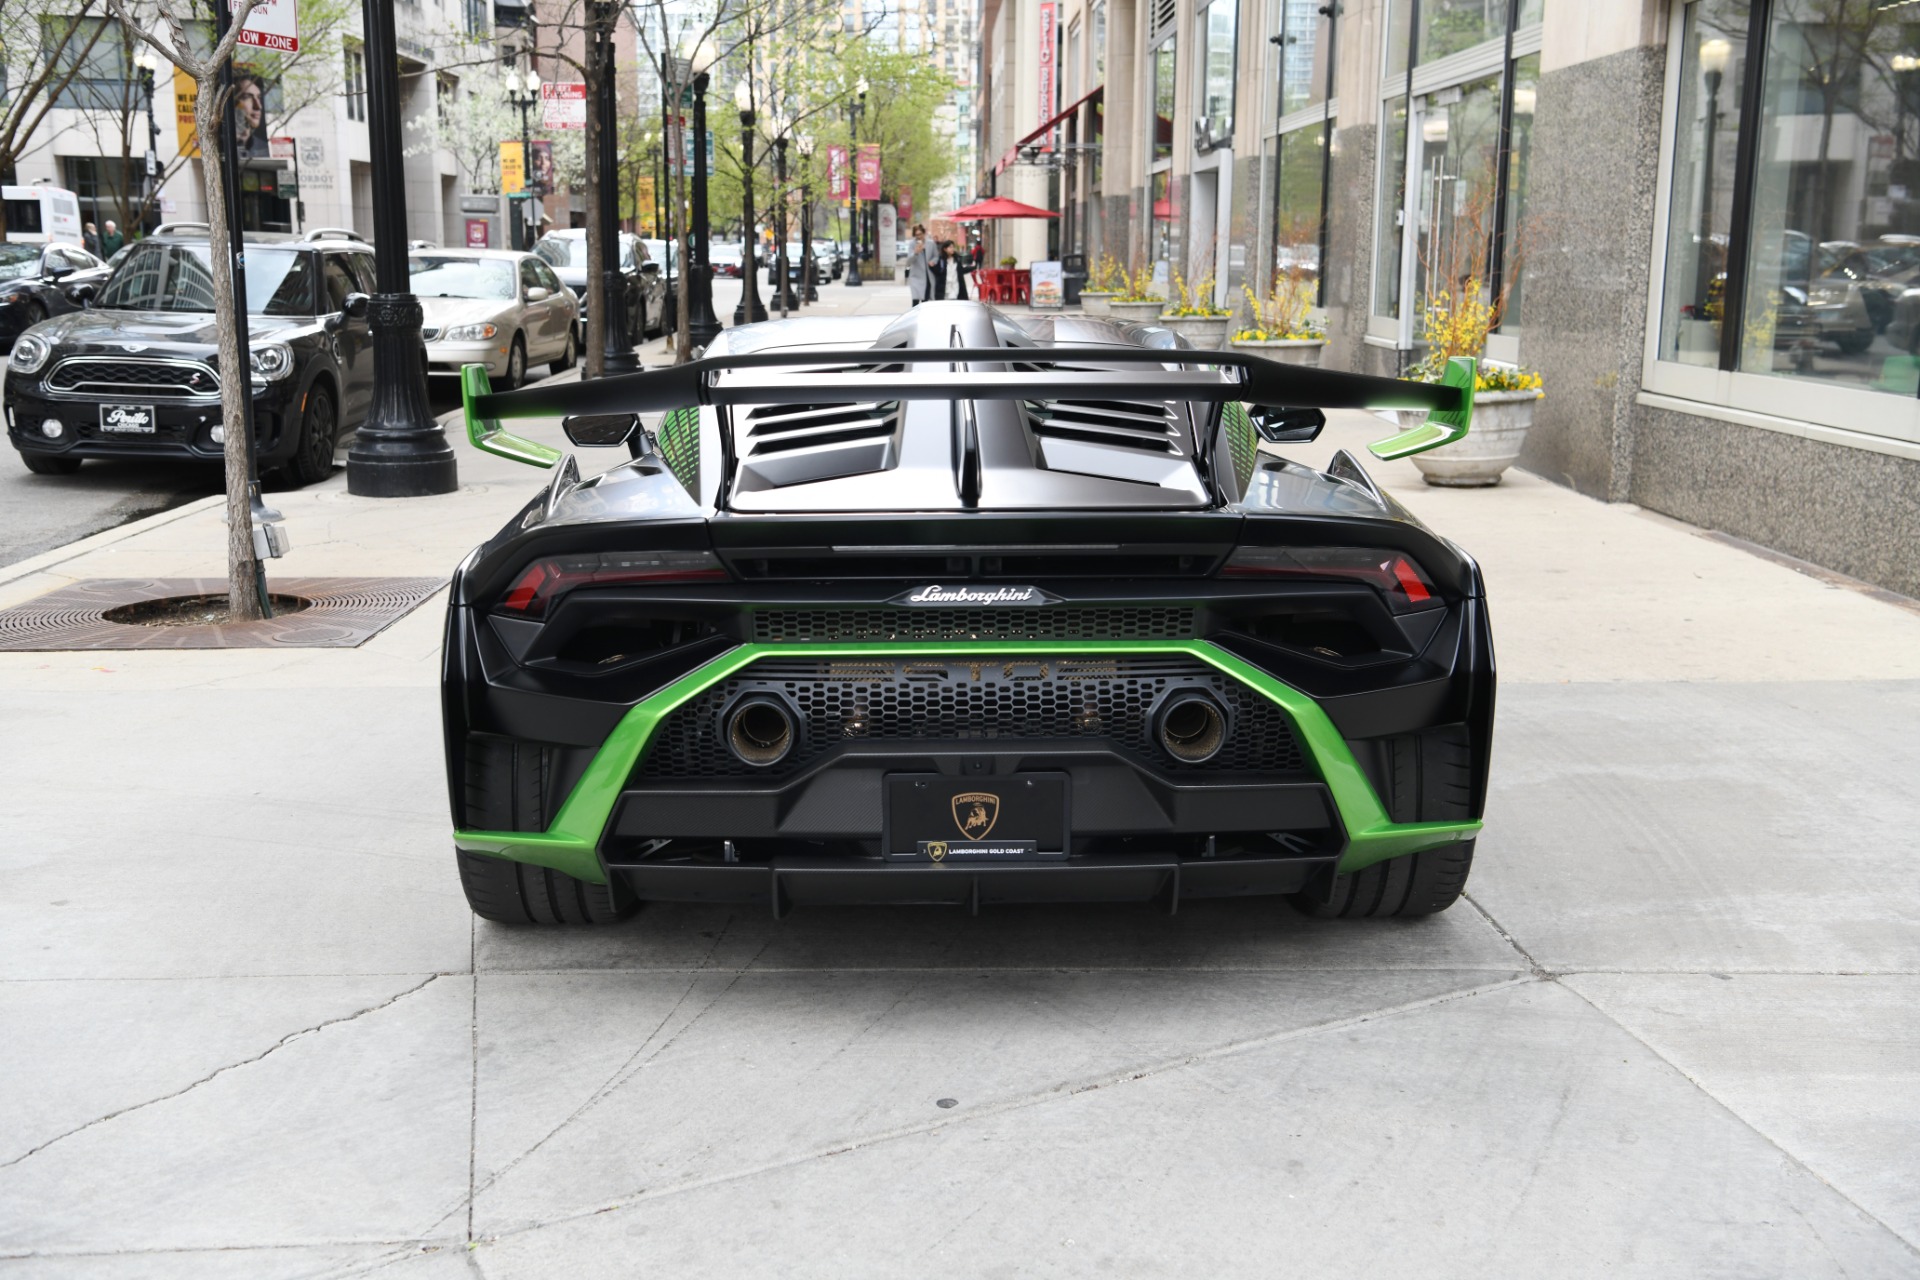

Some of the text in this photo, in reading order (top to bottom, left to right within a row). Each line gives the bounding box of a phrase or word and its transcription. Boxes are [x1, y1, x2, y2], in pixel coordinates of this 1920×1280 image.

[265, 34, 293, 50] ZONE
[1041, 9, 1050, 63] EPIC
[300, 175, 335, 183] ORBOY
[910, 585, 1032, 605] Lamborghini
[955, 795, 996, 805] LAMBORGHINI
